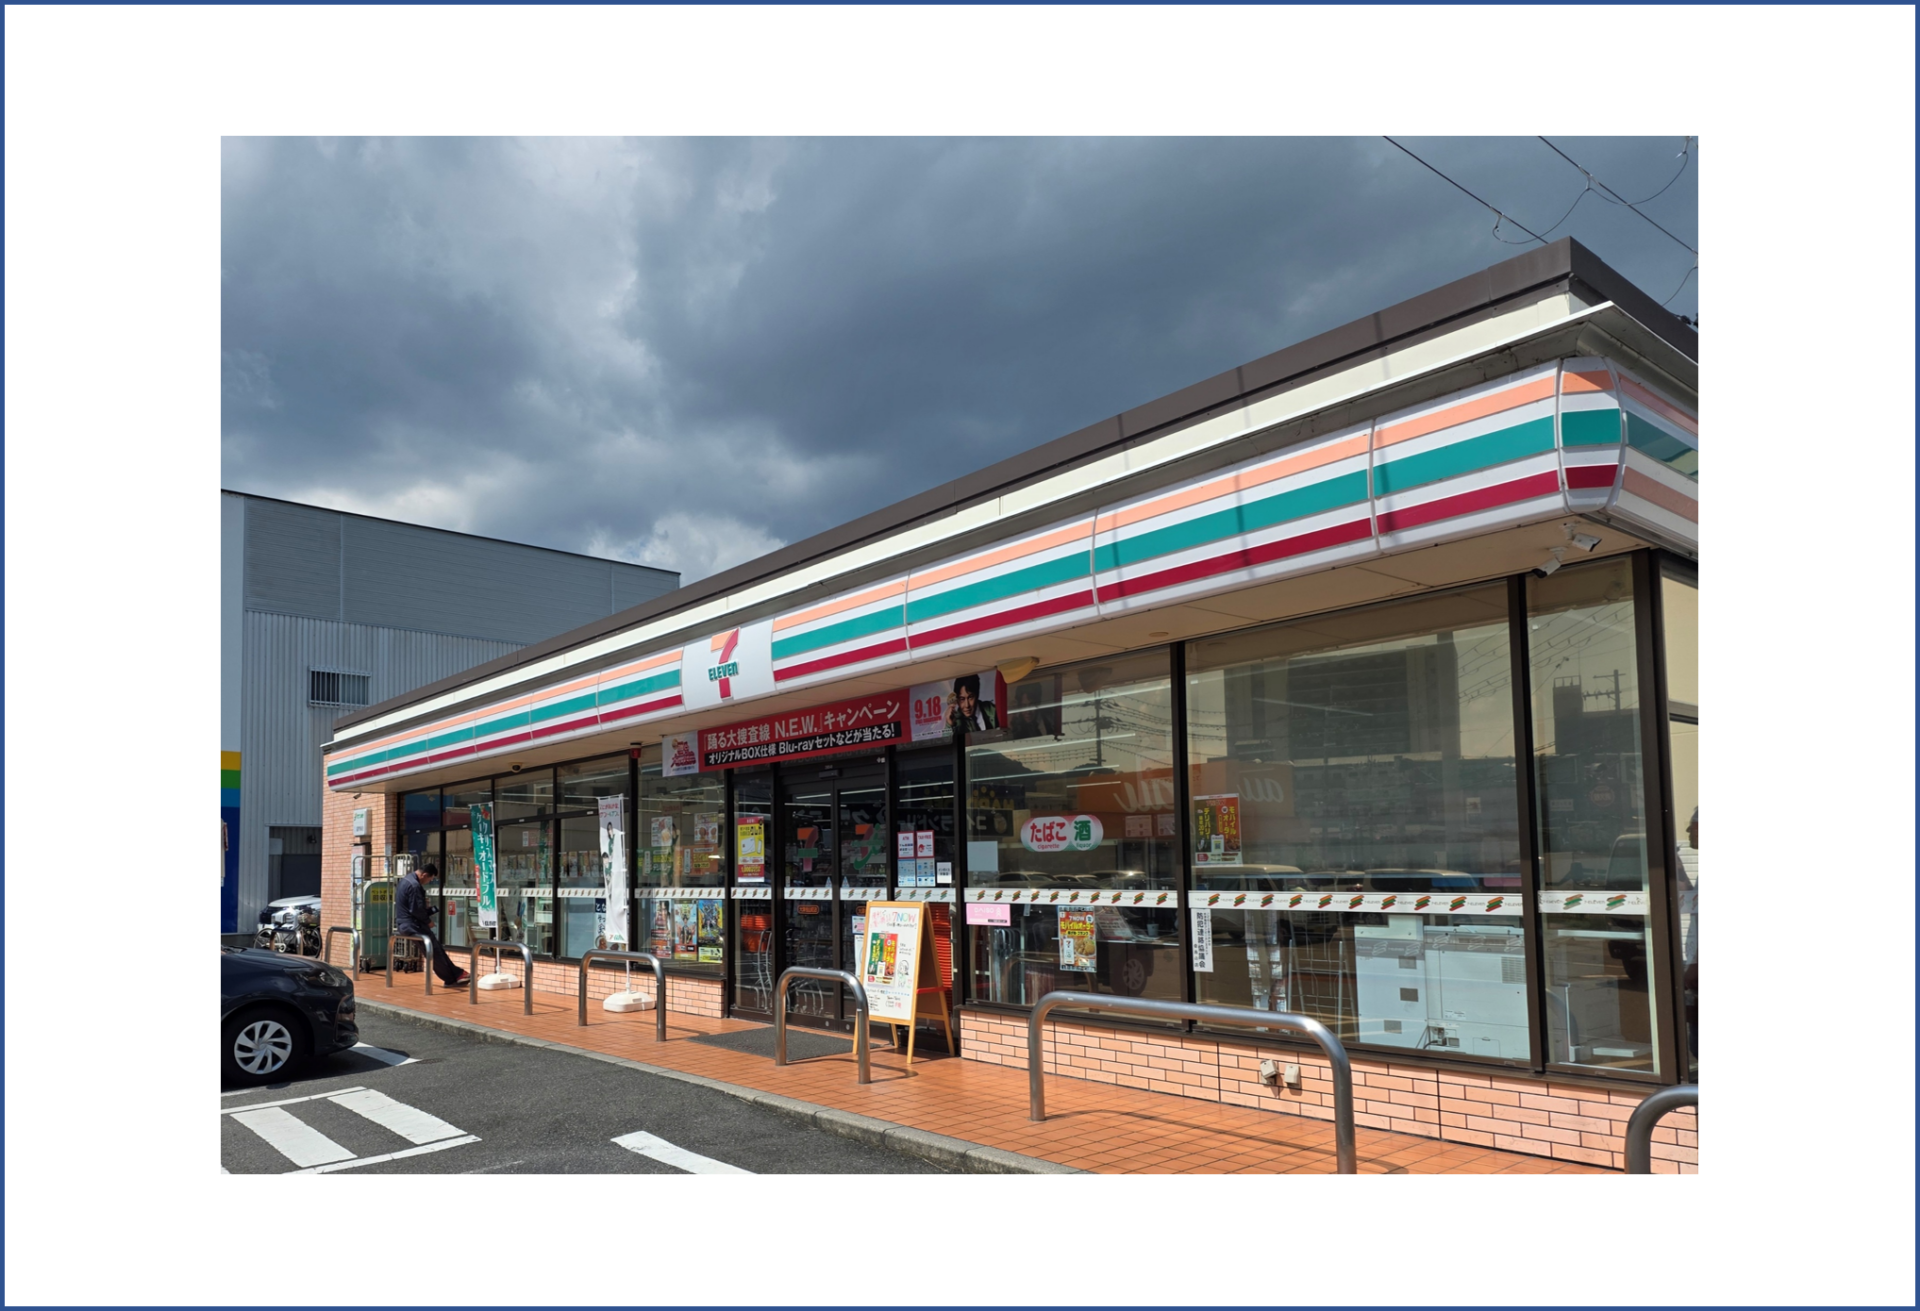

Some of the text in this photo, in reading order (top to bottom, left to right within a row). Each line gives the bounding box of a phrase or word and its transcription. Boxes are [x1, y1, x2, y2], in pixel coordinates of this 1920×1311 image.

[914, 695, 942, 719] 9.18
[704, 723, 771, 751] 『踊る大捜査線
[709, 743, 777, 765] オリジナルBOX仕様
[1030, 820, 1067, 842] たばこ
[1074, 820, 1091, 841] 酒
